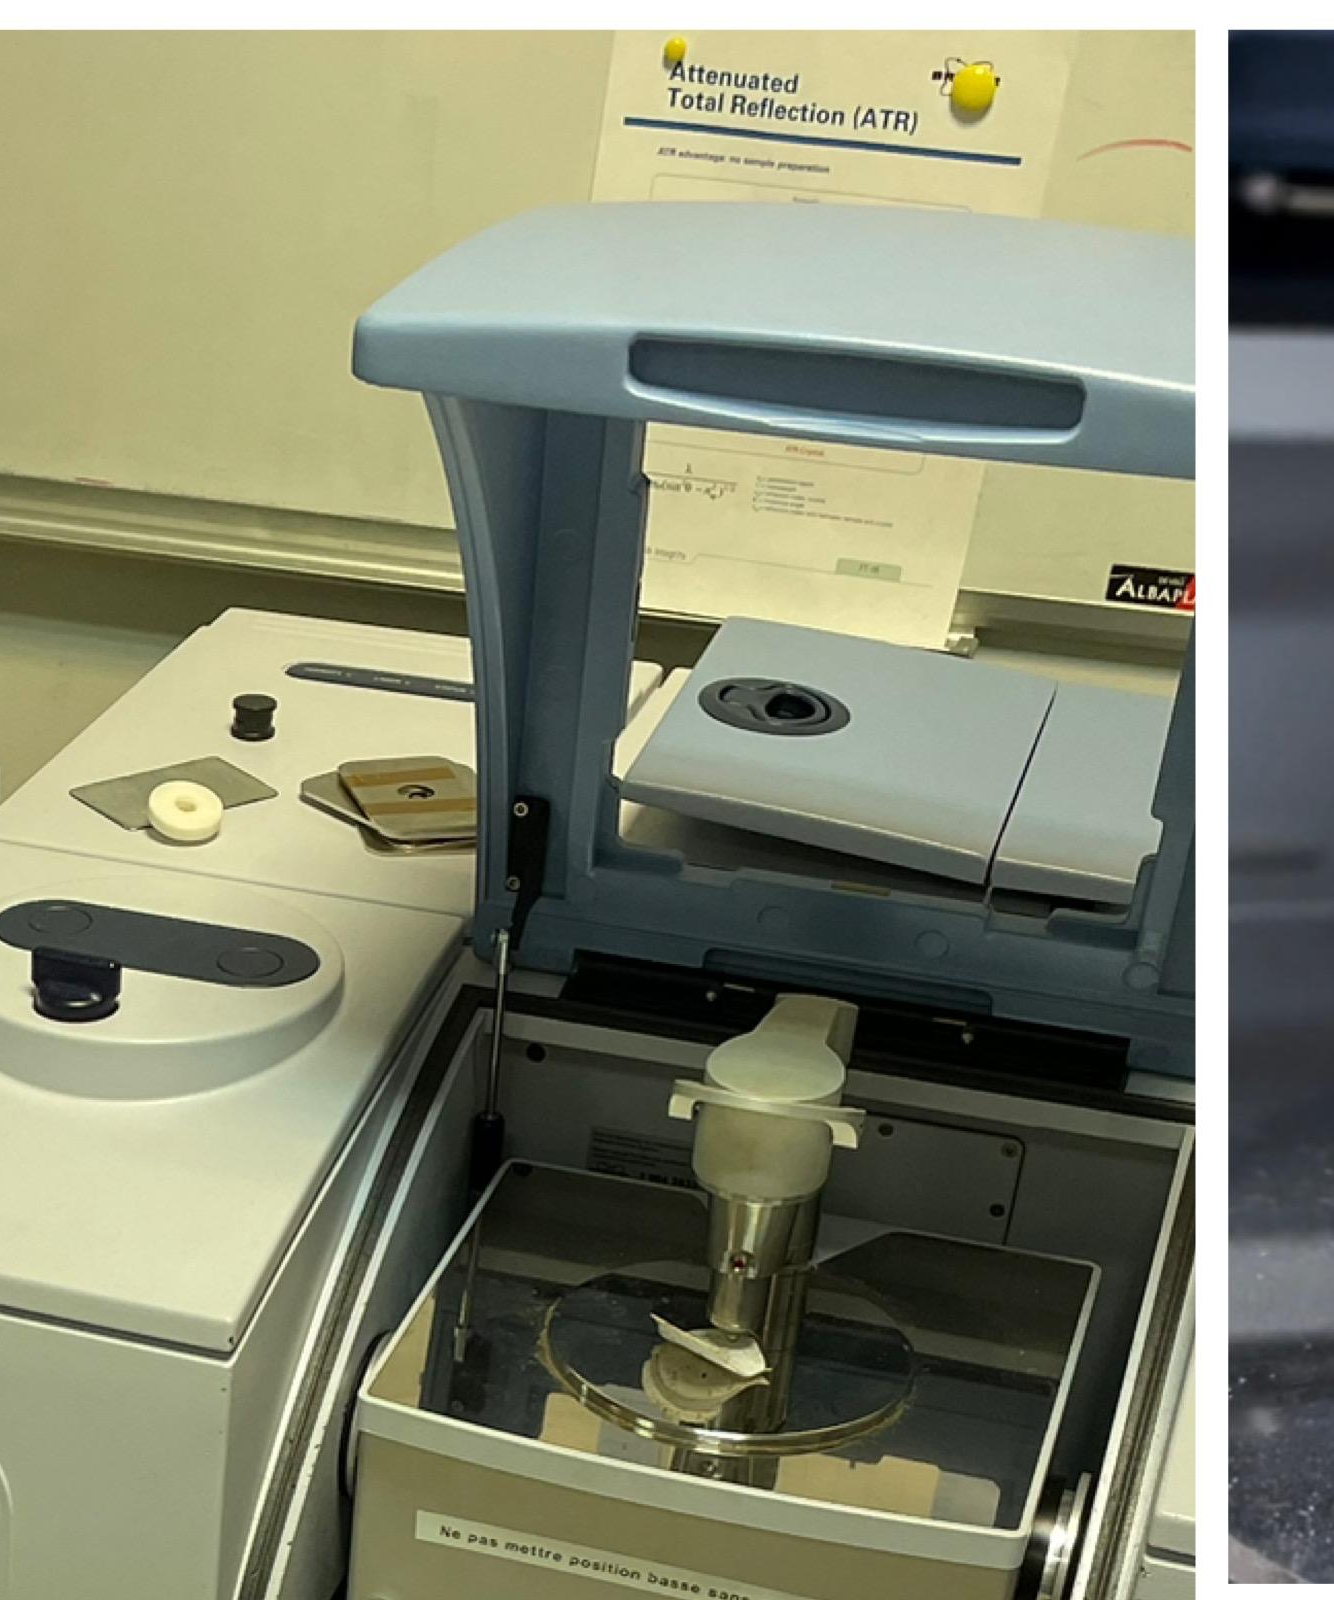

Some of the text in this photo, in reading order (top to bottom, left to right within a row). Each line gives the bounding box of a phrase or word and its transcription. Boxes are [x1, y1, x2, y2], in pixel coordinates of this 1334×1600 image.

[669, 60, 799, 95] Attenuated
[667, 87, 919, 135] Total Reflection (ATR)
[439, 1525, 462, 1540] Ne
[467, 1533, 498, 1548] pas
[504, 1541, 563, 1562] mettre
[568, 1556, 642, 1580] position
[646, 1572, 700, 1593] basse
